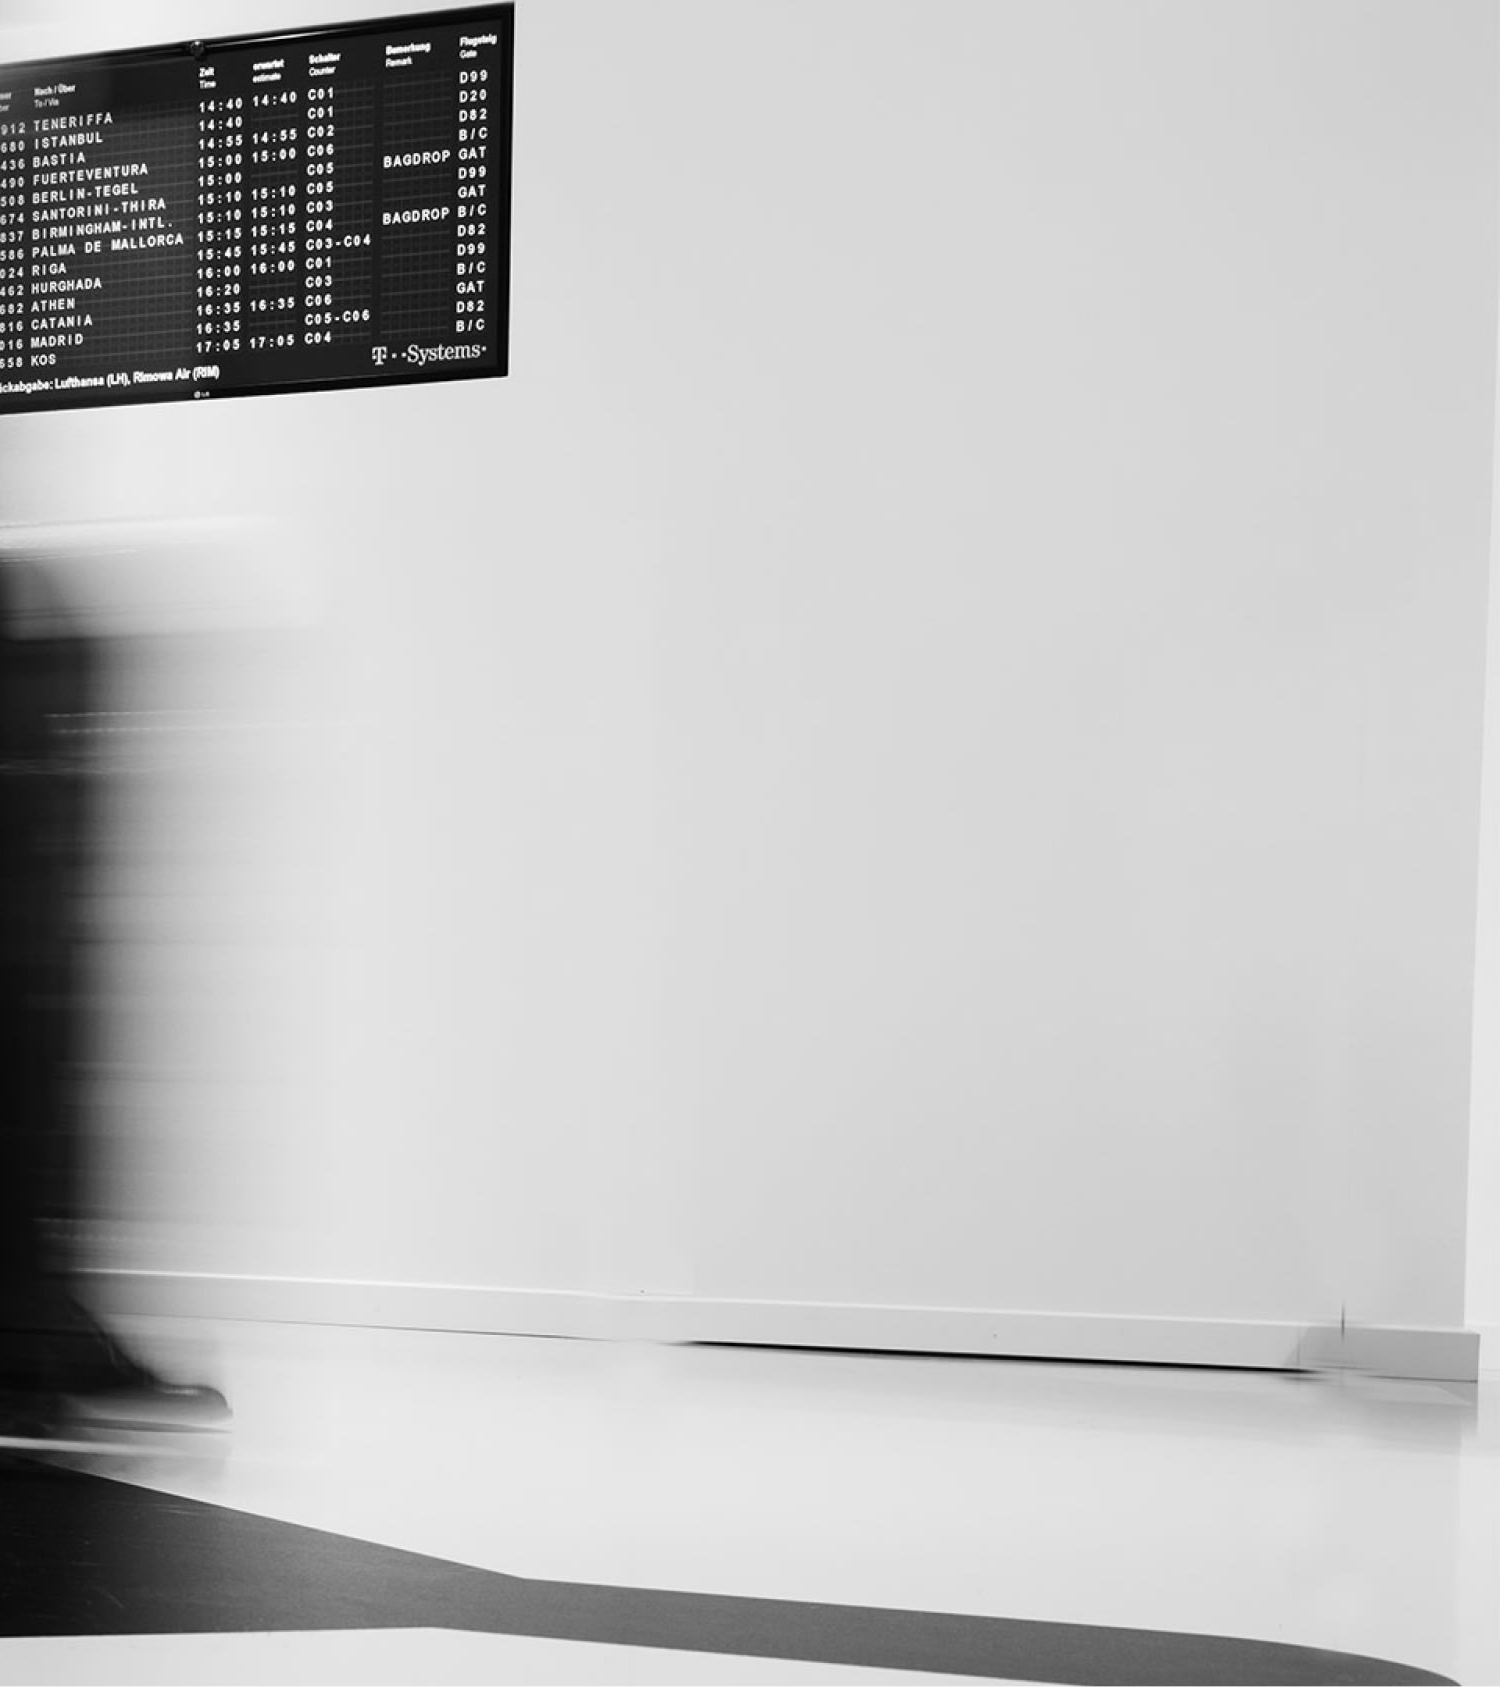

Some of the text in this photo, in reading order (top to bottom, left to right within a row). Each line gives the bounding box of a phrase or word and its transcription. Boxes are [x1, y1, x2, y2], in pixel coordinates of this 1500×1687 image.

[309, 66, 336, 76] Counter
[34, 112, 112, 132] TENERIFFA
[200, 98, 242, 112] 14:40
[253, 92, 297, 106] 14:40
[308, 87, 333, 100] C01
[460, 70, 487, 83] D99
[35, 132, 103, 149] ISTANBUL
[200, 117, 242, 131] 14:40
[308, 106, 333, 119] C01
[460, 89, 486, 103] D20
[1, 159, 25, 170] 436
[33, 152, 85, 167] BASTIA
[200, 134, 242, 150] 14:55
[253, 128, 297, 144] 14:55
[308, 125, 334, 138] C02
[459, 108, 486, 122] D82
[34, 164, 148, 185] FUERTEVENTURA
[199, 153, 242, 168] 15:00
[253, 148, 296, 163] 15:00
[307, 144, 333, 156] C06
[459, 127, 487, 141] B/C
[0, 213, 24, 225] 674
[33, 198, 166, 222] SANTORINI-THIRA
[198, 191, 241, 205] 15:10
[252, 185, 295, 200] 15:10
[307, 181, 333, 194] C05
[459, 166, 486, 179] D99
[1, 195, 24, 206] 508
[33, 183, 138, 203] BERLIN-TEGEL
[199, 172, 241, 187] 15:00
[307, 162, 333, 175] C05
[384, 150, 450, 168] BAGDROP
[459, 146, 486, 160] GAT
[0, 249, 23, 261] 586
[33, 244, 75, 258] PALMA
[85, 241, 100, 253] DE
[111, 234, 183, 250] MALLORCA
[198, 228, 241, 242] 15:15
[252, 222, 295, 237] 15:15
[306, 219, 333, 231] C04
[383, 207, 449, 225] BAGDROP
[458, 204, 486, 217] B/C
[33, 217, 172, 239] BIRMINGHAM-INTL.
[198, 209, 241, 223] 15:10
[252, 204, 295, 218] 15:10
[306, 200, 333, 213] C03
[458, 184, 485, 198] GAT
[32, 263, 66, 276] RIGA
[198, 246, 241, 261] 15:45
[251, 241, 295, 256] 15:45
[306, 234, 370, 250] C03-C04
[458, 223, 485, 236] D82
[32, 278, 102, 294] HURGHADA
[197, 265, 240, 279] 16:00
[251, 260, 294, 274] 16:00
[306, 256, 331, 269] C01
[458, 242, 485, 256] D99
[0, 303, 23, 314] 682
[31, 298, 75, 312] ATHEN
[197, 284, 239, 297] 16:20
[306, 275, 332, 288] C03
[457, 261, 485, 275] B/C
[0, 321, 23, 333] 816
[31, 314, 92, 330] CATANIA
[197, 302, 240, 316] 16:35
[251, 297, 294, 311] 16:35
[305, 294, 331, 306] C06
[457, 281, 484, 294] GAT
[31, 334, 83, 348] MADRID
[197, 320, 239, 334] 16:35
[305, 309, 369, 325] C05-C06
[456, 300, 484, 312] D82
[31, 354, 56, 366] KOS
[197, 339, 239, 353] 17:05
[250, 334, 294, 348] 17:05
[305, 331, 331, 344] C04
[456, 319, 484, 332] B/C
[54, 375, 104, 390] Lufthansa
[107, 372, 130, 387] (LH),
[133, 370, 173, 383] Rimowa
[175, 368, 190, 381] Air
[192, 365, 220, 381] (RIM)
